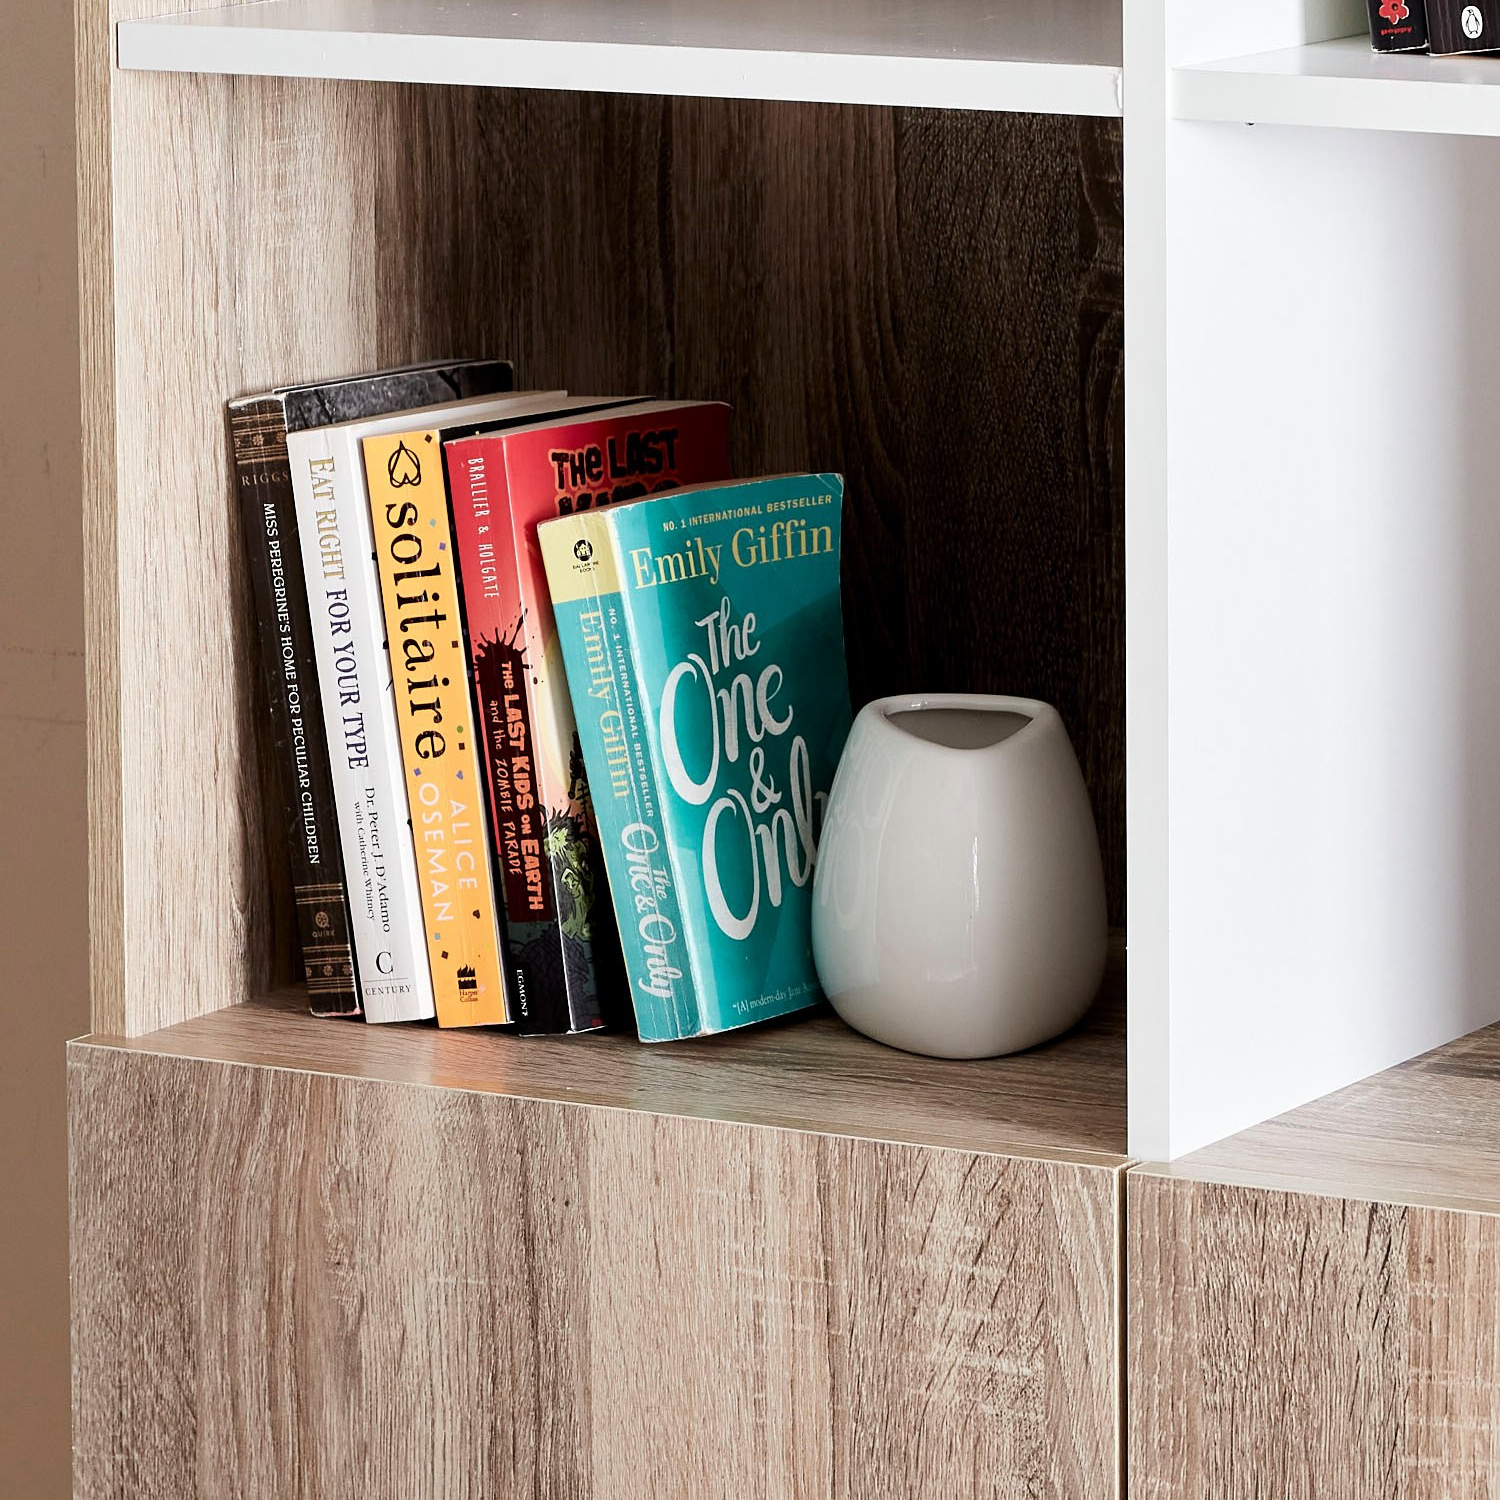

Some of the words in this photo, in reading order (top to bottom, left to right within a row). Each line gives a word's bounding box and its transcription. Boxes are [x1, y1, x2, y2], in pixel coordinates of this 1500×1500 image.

[241, 470, 289, 487] RIGGS
[308, 456, 336, 500] EAT
[606, 427, 679, 480] LAST
[467, 457, 491, 517] BRALLIER
[663, 521, 678, 532] NO.
[680, 518, 687, 528] 1
[689, 505, 763, 527] INTERNATIONAL
[767, 494, 833, 513] BESTSELLER
[263, 503, 279, 537] MISS
[315, 508, 346, 580] RIGHT
[478, 526, 490, 534] &
[478, 544, 500, 599] HOLGATE
[629, 537, 723, 590] Emily
[731, 518, 834, 568] Giffin
[268, 540, 291, 633] PEREGRINE'S
[325, 588, 352, 637] FOR
[385, 501, 448, 760] solitaire
[607, 608, 618, 629] NO.
[613, 633, 620, 641] 1
[695, 596, 761, 675] The
[281, 637, 297, 680] HOME
[333, 641, 362, 707] YOUR
[287, 684, 301, 715] FOR
[488, 699, 499, 724] and
[579, 610, 612, 706] Emily
[599, 709, 630, 798] Giffin
[615, 646, 638, 738] INTERNATIONAL
[342, 712, 370, 770] TYPE
[493, 729, 502, 750] the
[503, 694, 526, 751] LAST
[659, 653, 793, 806] One
[291, 717, 310, 788] PECULIAR
[750, 746, 782, 814] &
[365, 787, 376, 809] Dr.
[495, 758, 513, 813] ZOMBIE
[511, 755, 534, 811] KIDS
[633, 743, 654, 818] BESTSELLER
[301, 791, 320, 865] CHILDREN
[354, 801, 364, 825] with
[368, 812, 381, 849] Peter
[521, 815, 532, 835] ON
[702, 735, 828, 941] Onl
[357, 827, 370, 876] Catherine
[372, 852, 383, 862] J.
[419, 782, 454, 921] OSEMAN
[449, 799, 478, 890] ALICE
[502, 821, 522, 876] PARADE
[621, 822, 660, 892] One
[364, 877, 376, 921] Whitney
[375, 865, 391, 933] D'Adamo
[521, 838, 544, 911] EARTH
[652, 864, 672, 901] The
[634, 895, 657, 914] &
[312, 930, 335, 938] QUIRK
[638, 912, 683, 999] Only
[365, 984, 412, 996] CENTURY
[375, 951, 394, 975] C
